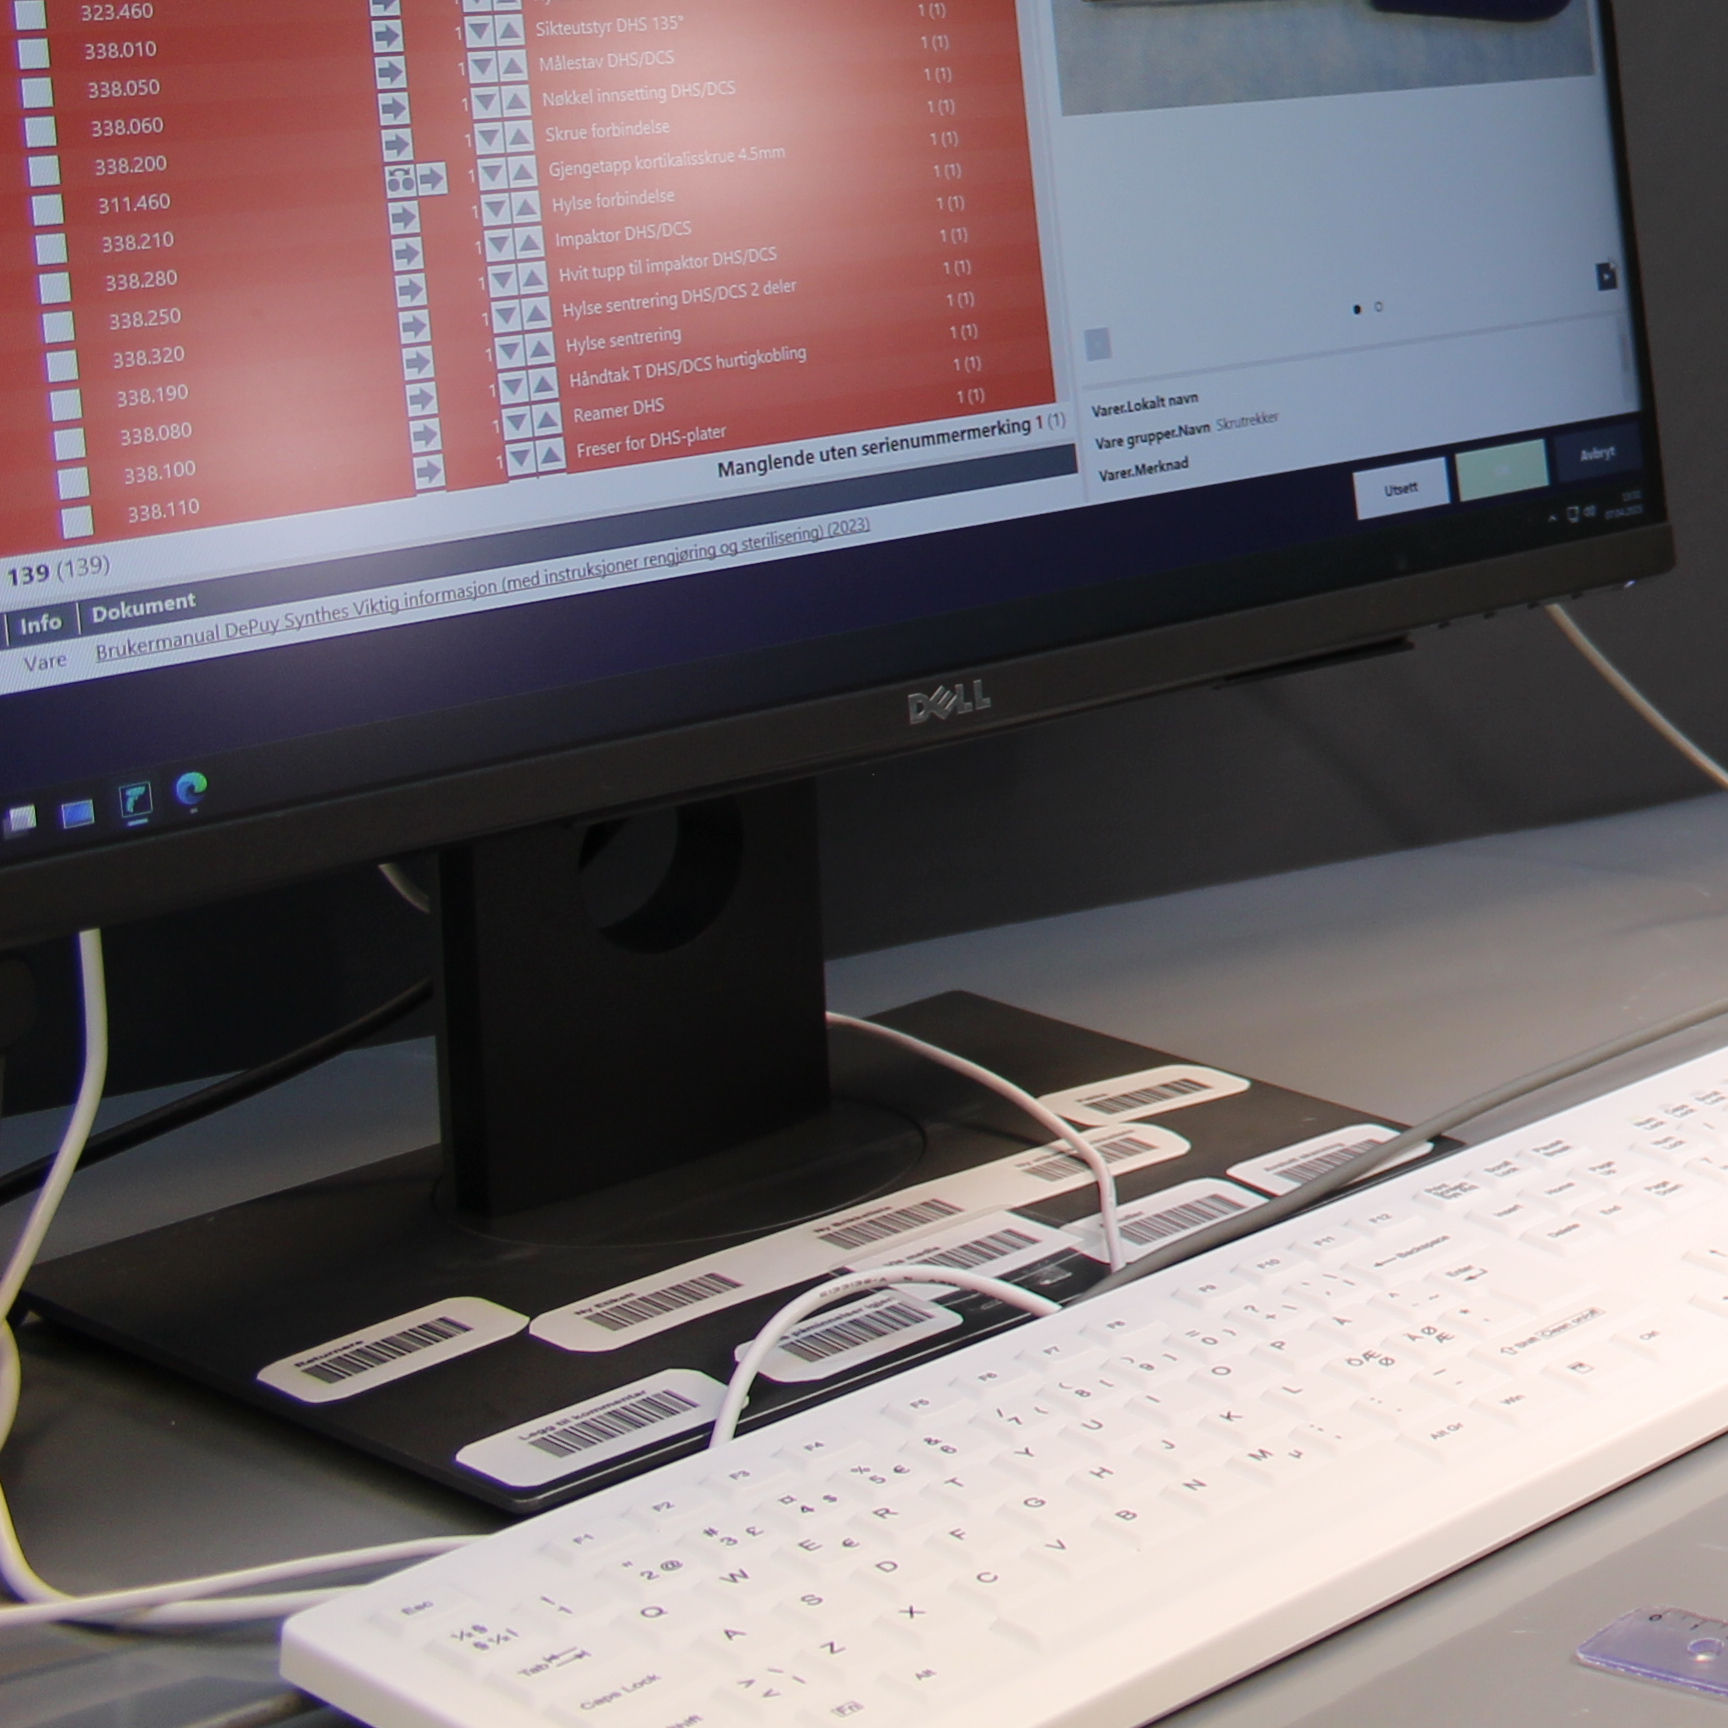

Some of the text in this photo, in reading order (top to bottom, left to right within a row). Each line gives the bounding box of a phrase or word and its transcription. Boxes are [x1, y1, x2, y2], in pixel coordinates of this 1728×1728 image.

[81, 3, 153, 21] 323.460
[535, 15, 683, 37] Sikteutstyr DHS 135°
[85, 41, 157, 60] 338.010
[539, 50, 675, 71] Målestav DHS/DCS
[88, 79, 160, 98] 338.050
[542, 80, 735, 106] Nøkkel innsetting DHS/DCS
[91, 117, 164, 137] 338.060
[545, 120, 670, 142] Skrue forbindelse
[95, 155, 167, 176] 338.200
[548, 146, 785, 180] Gjengetapp kortikalisskrue 4.5mm
[98, 193, 171, 215] 311.460
[552, 188, 675, 215] Hylse forbindelse
[102, 231, 174, 253] 338.210
[555, 220, 691, 249] Impaktor DHS/DCS
[559, 246, 777, 282] Hvit tupp til impaktor DHS/DCS
[106, 269, 178, 292] 338.280
[562, 278, 797, 320] Hylse sentrering DHS/DCS 2 deler
[109, 308, 181, 330] 338.250
[566, 326, 681, 356] Hylse sentrering
[113, 345, 185, 369] 338.320
[569, 346, 806, 387] Håndtak T DHS/DCS hurtigkobling
[117, 384, 189, 407] 338.190
[1168, 394, 1198, 406] navn
[573, 397, 664, 422] Reamer DHS
[121, 422, 192, 446] 338.080
[577, 426, 726, 457] Freser for DHS-plater
[1095, 437, 1124, 449] Vare
[1218, 414, 1276, 431] Skrutrekker
[717, 450, 814, 477] Manglende
[819, 446, 857, 462] uten
[861, 418, 1031, 455] serienummermerking
[1036, 415, 1042, 429] 1
[1580, 446, 1616, 462] Avbryt
[124, 460, 196, 485] 338.100
[1384, 481, 1419, 497] Utsett
[128, 498, 200, 523] 338.110
[8, 555, 110, 586] 139 (139)
[96, 516, 870, 662] Brukermanual DePuy Synthes Viktig informasjon (med instruksjoner rengjøring og sterilisering) (2023)
[92, 592, 196, 624] Dokument
[21, 614, 62, 635] Info
[24, 653, 67, 671] Vare
[908, 679, 992, 724] DELL
[1396, 1234, 1450, 1258] Backspace
[294, 1340, 364, 1368] Returnere
[518, 1426, 556, 1440] Legg
[572, 1389, 648, 1420] kommentar
[874, 1506, 900, 1520] R
[719, 1569, 751, 1585] W
[640, 1606, 668, 1619] Q
[517, 1664, 550, 1676] Tab
[580, 1675, 662, 1710] Caps Lock
